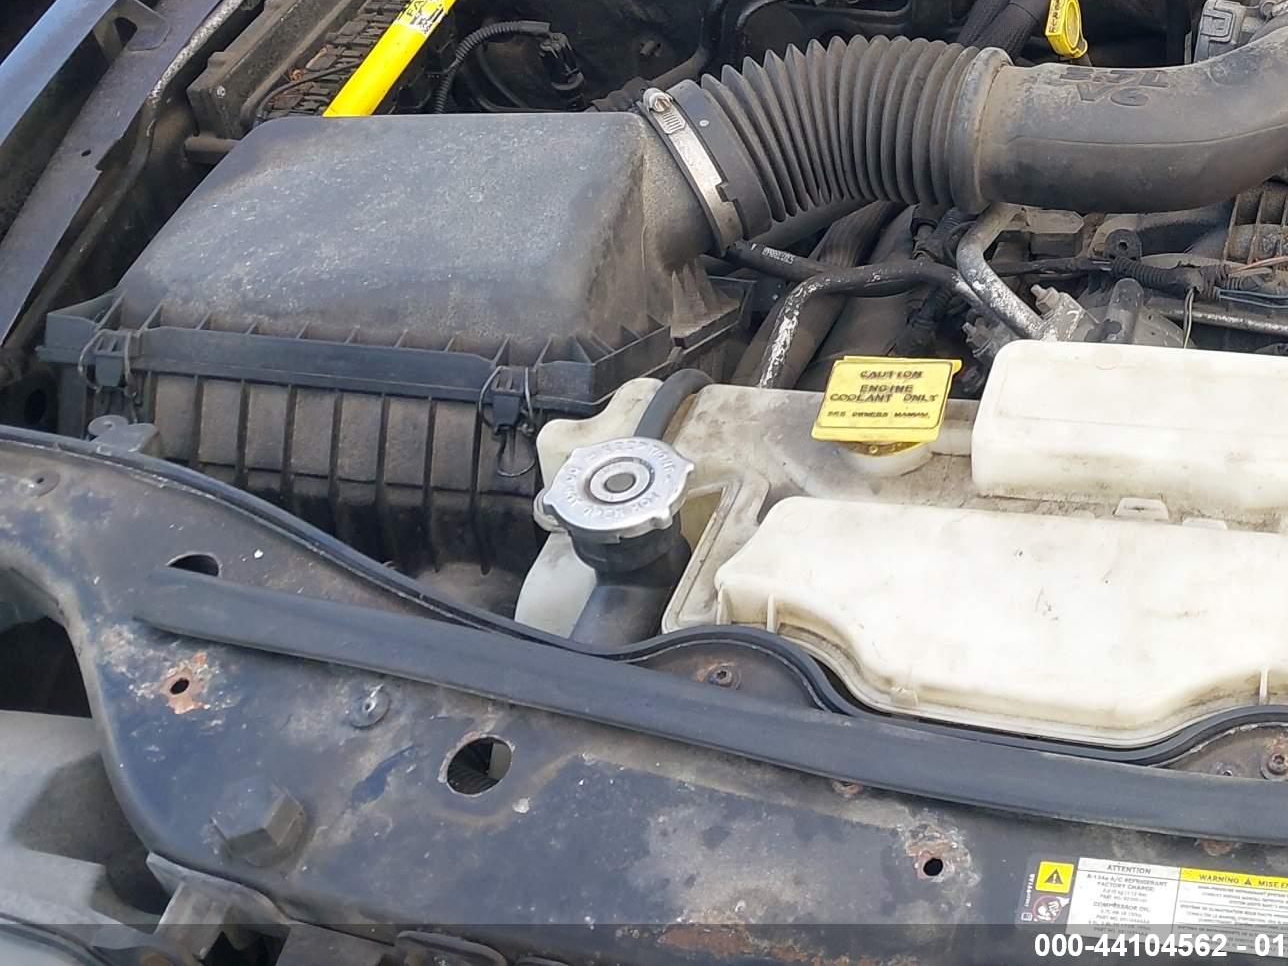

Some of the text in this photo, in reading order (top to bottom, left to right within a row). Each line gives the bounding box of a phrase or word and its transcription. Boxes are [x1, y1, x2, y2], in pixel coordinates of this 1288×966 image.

[859, 369, 924, 379] CAUTION
[859, 384, 914, 394] ENGINE
[829, 393, 939, 403] COOLANT ONLY
[1106, 864, 1152, 875] ATTENTION
[1199, 873, 1240, 885] WARNING
[1257, 879, 1279, 888] MISE
